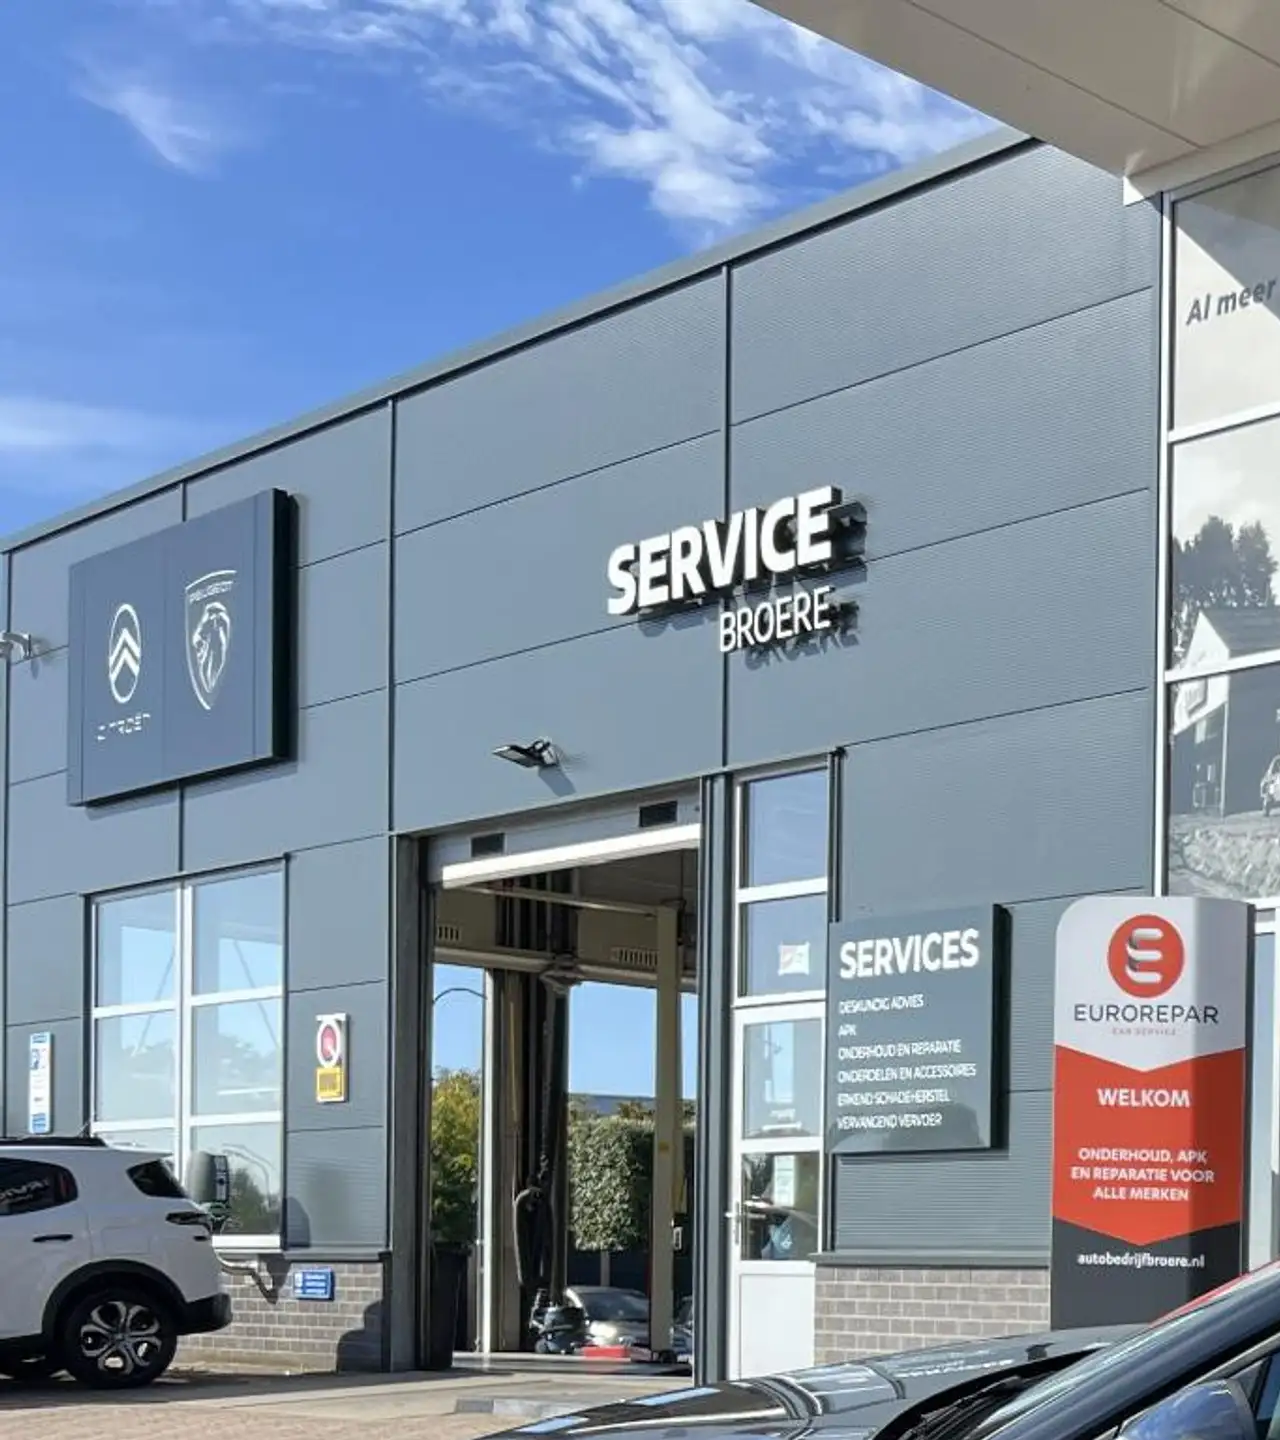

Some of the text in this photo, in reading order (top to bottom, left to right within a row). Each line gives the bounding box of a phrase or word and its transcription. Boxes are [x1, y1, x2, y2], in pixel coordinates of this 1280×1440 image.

[1186, 294, 1212, 326] Al
[1216, 278, 1277, 317] meer
[607, 485, 833, 615] SERVICE
[719, 585, 832, 653] BROERE
[839, 927, 981, 980] SERVICES
[891, 993, 925, 1010] ADVIES
[1073, 1003, 1220, 1025] EUROREPAR
[838, 1023, 858, 1037] APK
[837, 1039, 962, 1061] ONDERHOUD EN REPARATIE
[837, 1067, 898, 1083] ONDERDELEN
[899, 1066, 913, 1080] EN
[1097, 1087, 1191, 1108] WELKOM
[898, 1111, 943, 1129] VERVOER
[1078, 1148, 1174, 1164] ONDERHOUD,
[1071, 1166, 1215, 1184] EN REPARATIE VOOR
[1093, 1187, 1190, 1201] ALLE MERKEN
[1077, 1251, 1206, 1270] autobedrijfbroere.nl
